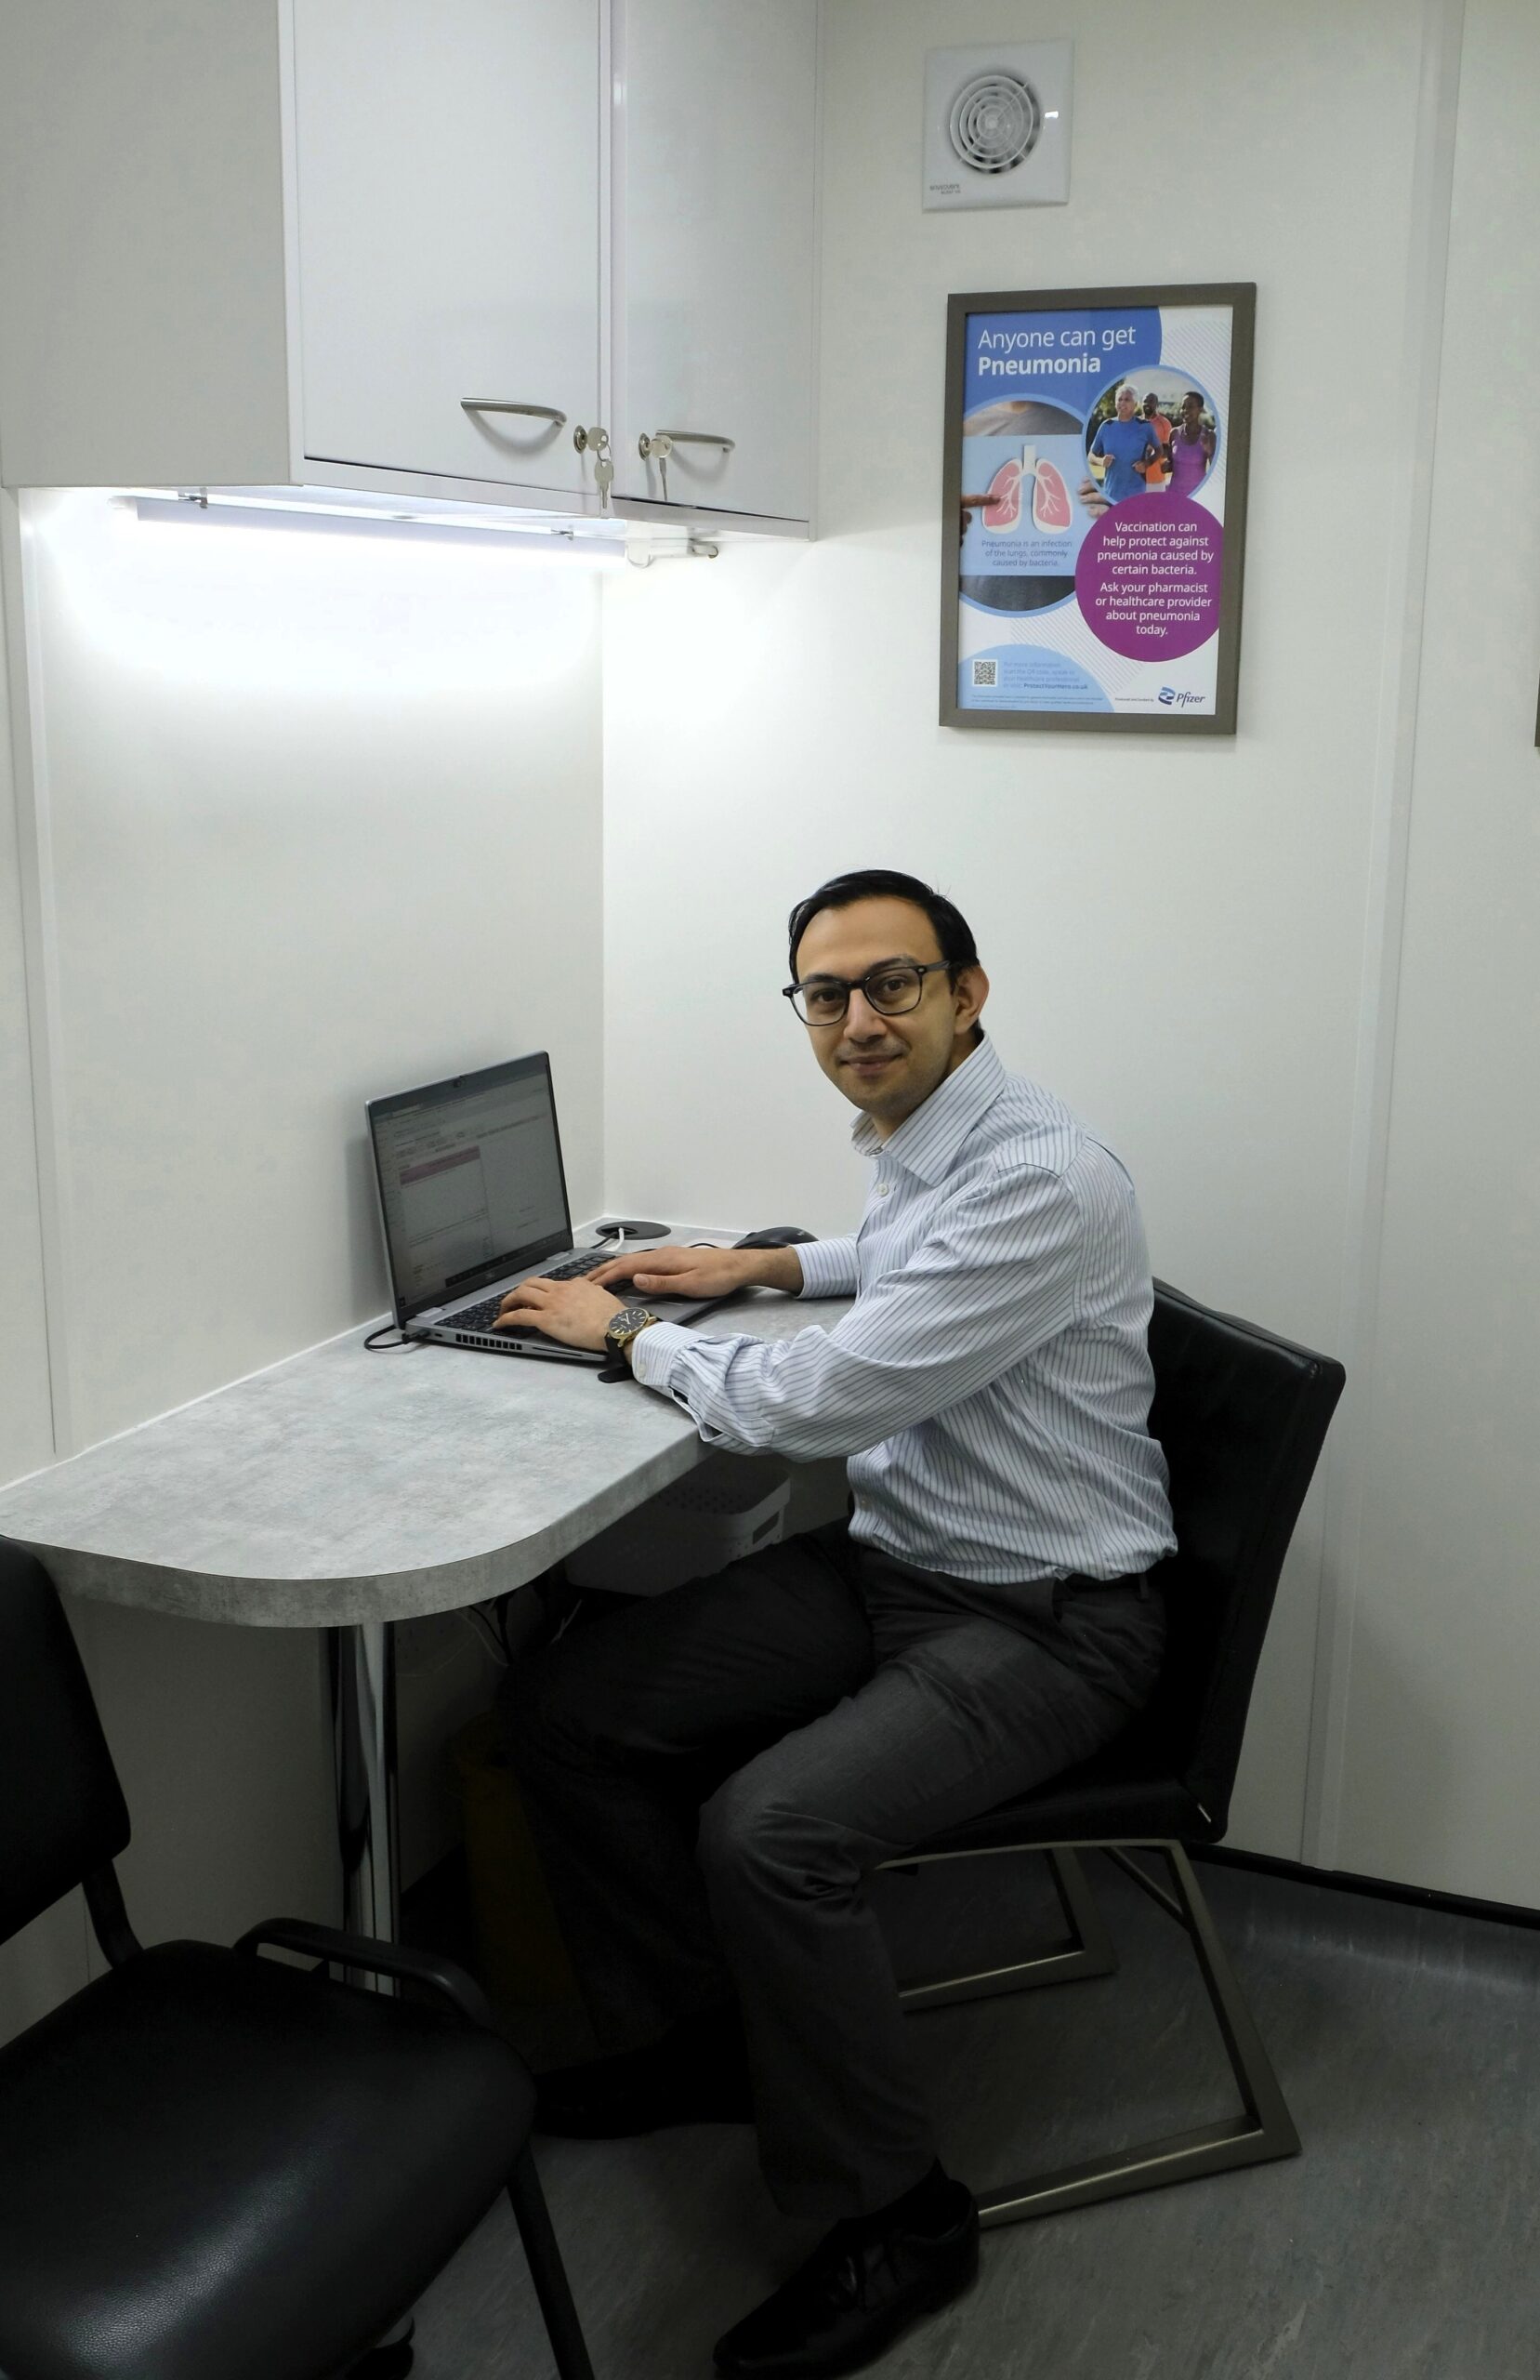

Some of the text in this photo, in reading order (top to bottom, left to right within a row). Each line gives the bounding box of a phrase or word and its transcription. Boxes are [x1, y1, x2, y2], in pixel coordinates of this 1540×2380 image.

[978, 326, 1137, 353] Anyone can get
[978, 352, 1100, 376] Pneumonia
[1115, 522, 1197, 532] Vaccination can
[981, 539, 1022, 548] Pneumonia
[1103, 536, 1209, 549] help protect against
[1030, 549, 1068, 558] commonly
[1098, 550, 1215, 562] pneumonia caused by
[1112, 564, 1197, 575] certain bacteria.
[1100, 582, 1208, 594] Ask your pharmacist
[1095, 596, 1212, 609] or healthcare provider
[1106, 610, 1200, 622] about pneumonia
[1137, 625, 1168, 637] today.
[1176, 692, 1205, 707] Pfizer
